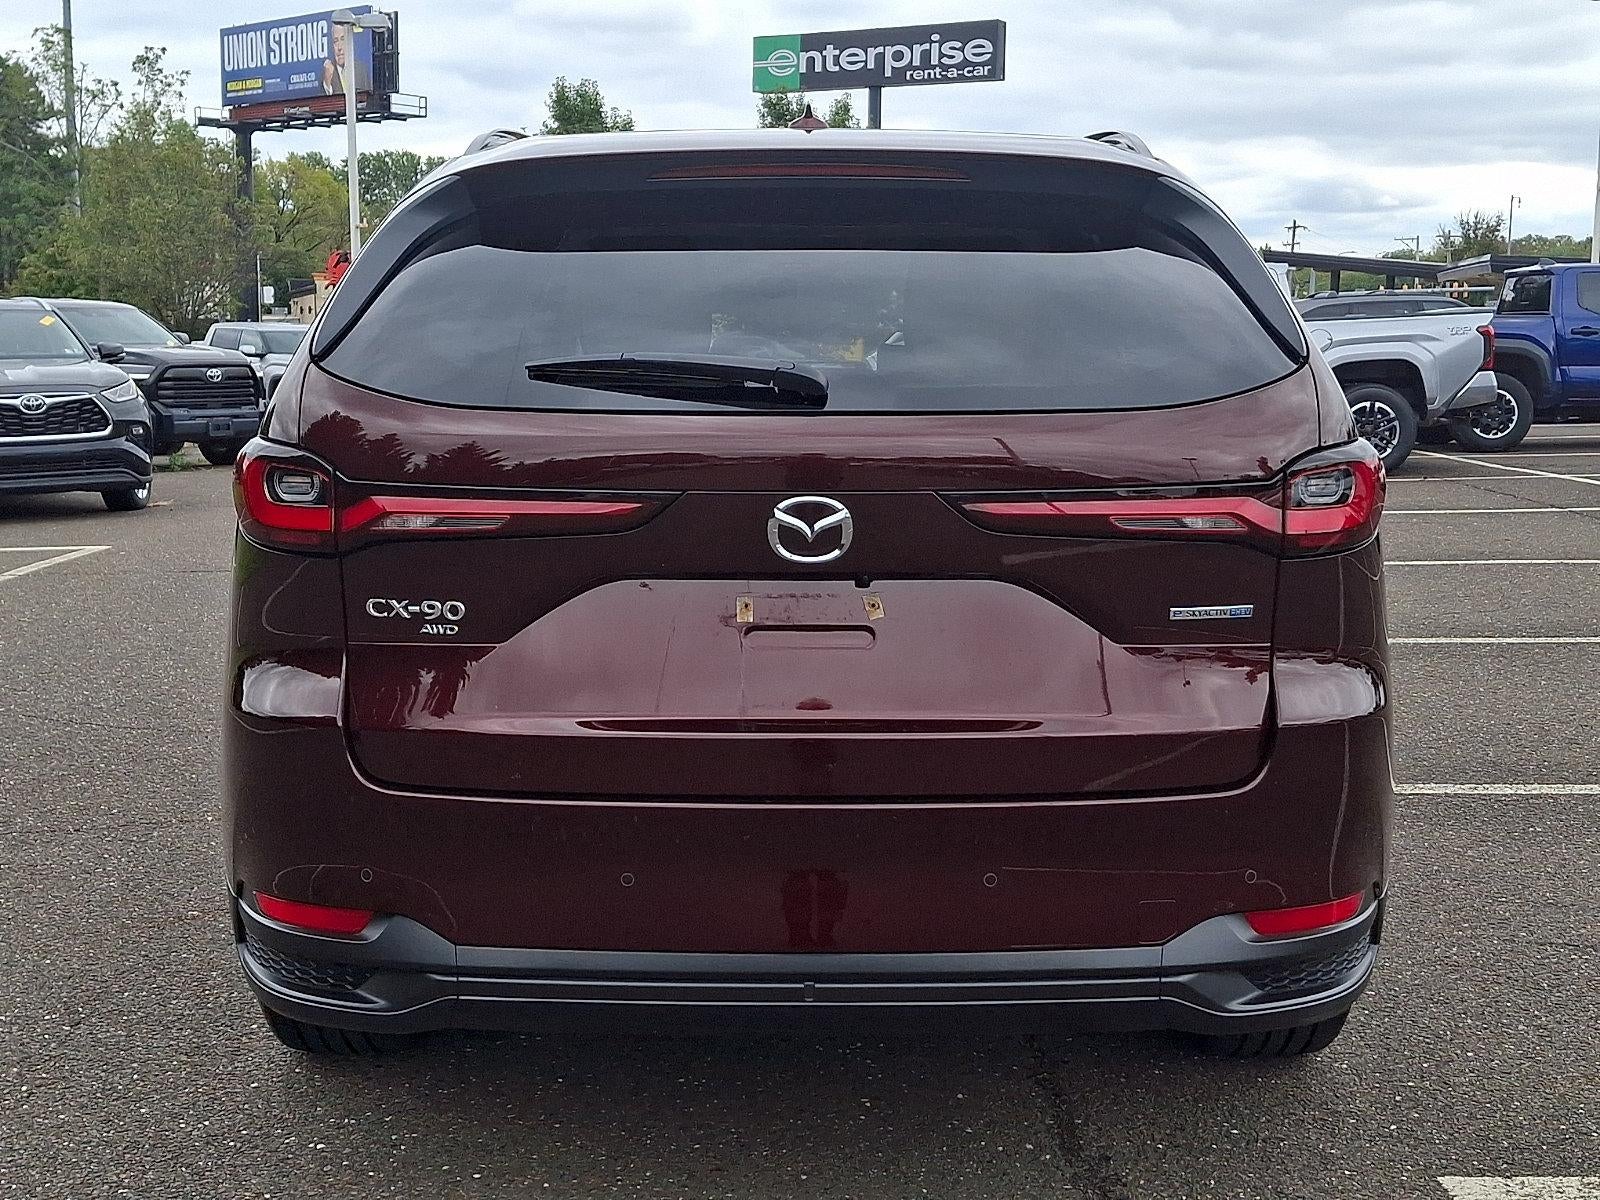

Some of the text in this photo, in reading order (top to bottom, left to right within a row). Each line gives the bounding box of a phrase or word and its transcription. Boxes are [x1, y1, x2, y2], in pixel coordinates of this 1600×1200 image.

[223, 20, 328, 72] UNION STRONG
[767, 33, 993, 78] enterprise
[905, 64, 991, 81] rent-a-car
[366, 598, 466, 620] CX-90
[420, 623, 459, 635] AWD
